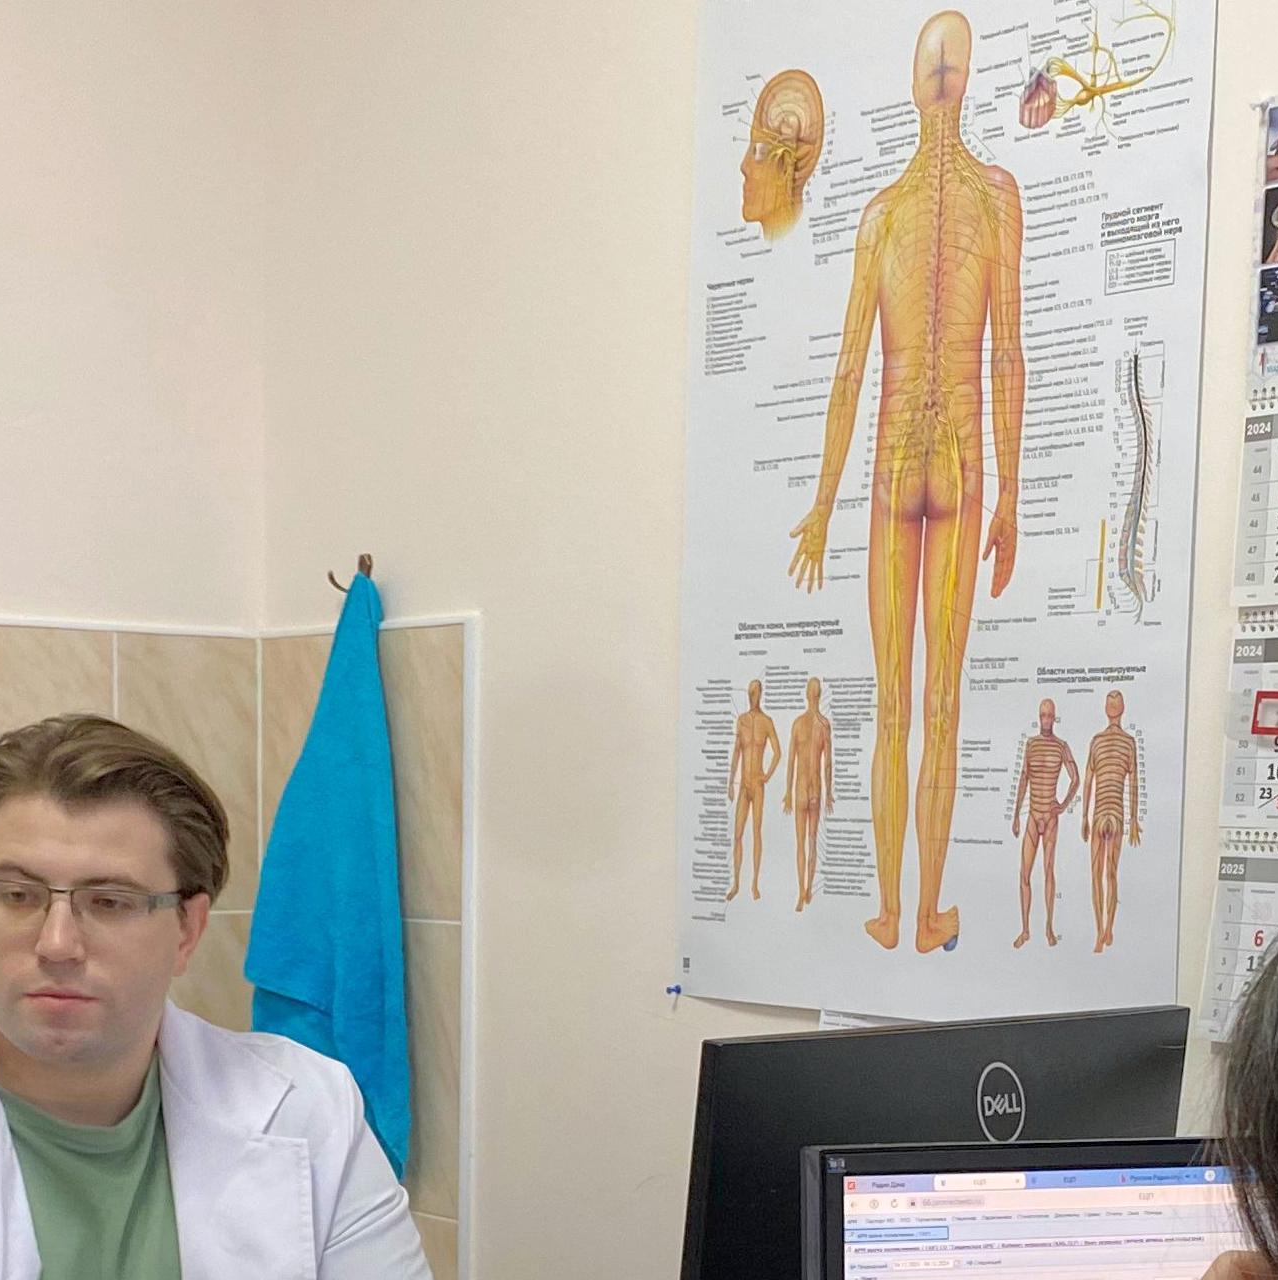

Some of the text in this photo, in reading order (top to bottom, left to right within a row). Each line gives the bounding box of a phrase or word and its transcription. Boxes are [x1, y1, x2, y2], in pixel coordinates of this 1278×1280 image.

[1101, 203, 1164, 221] Грудной сегмент
[1101, 212, 1159, 229] спинного мозга
[1162, 217, 1179, 227] него
[1247, 422, 1271, 435] 2024
[1236, 646, 1262, 657] 2024
[1259, 787, 1272, 799] 23
[1221, 863, 1245, 874] 2025
[1254, 930, 1264, 946] 6
[983, 1093, 1021, 1116] DELL
